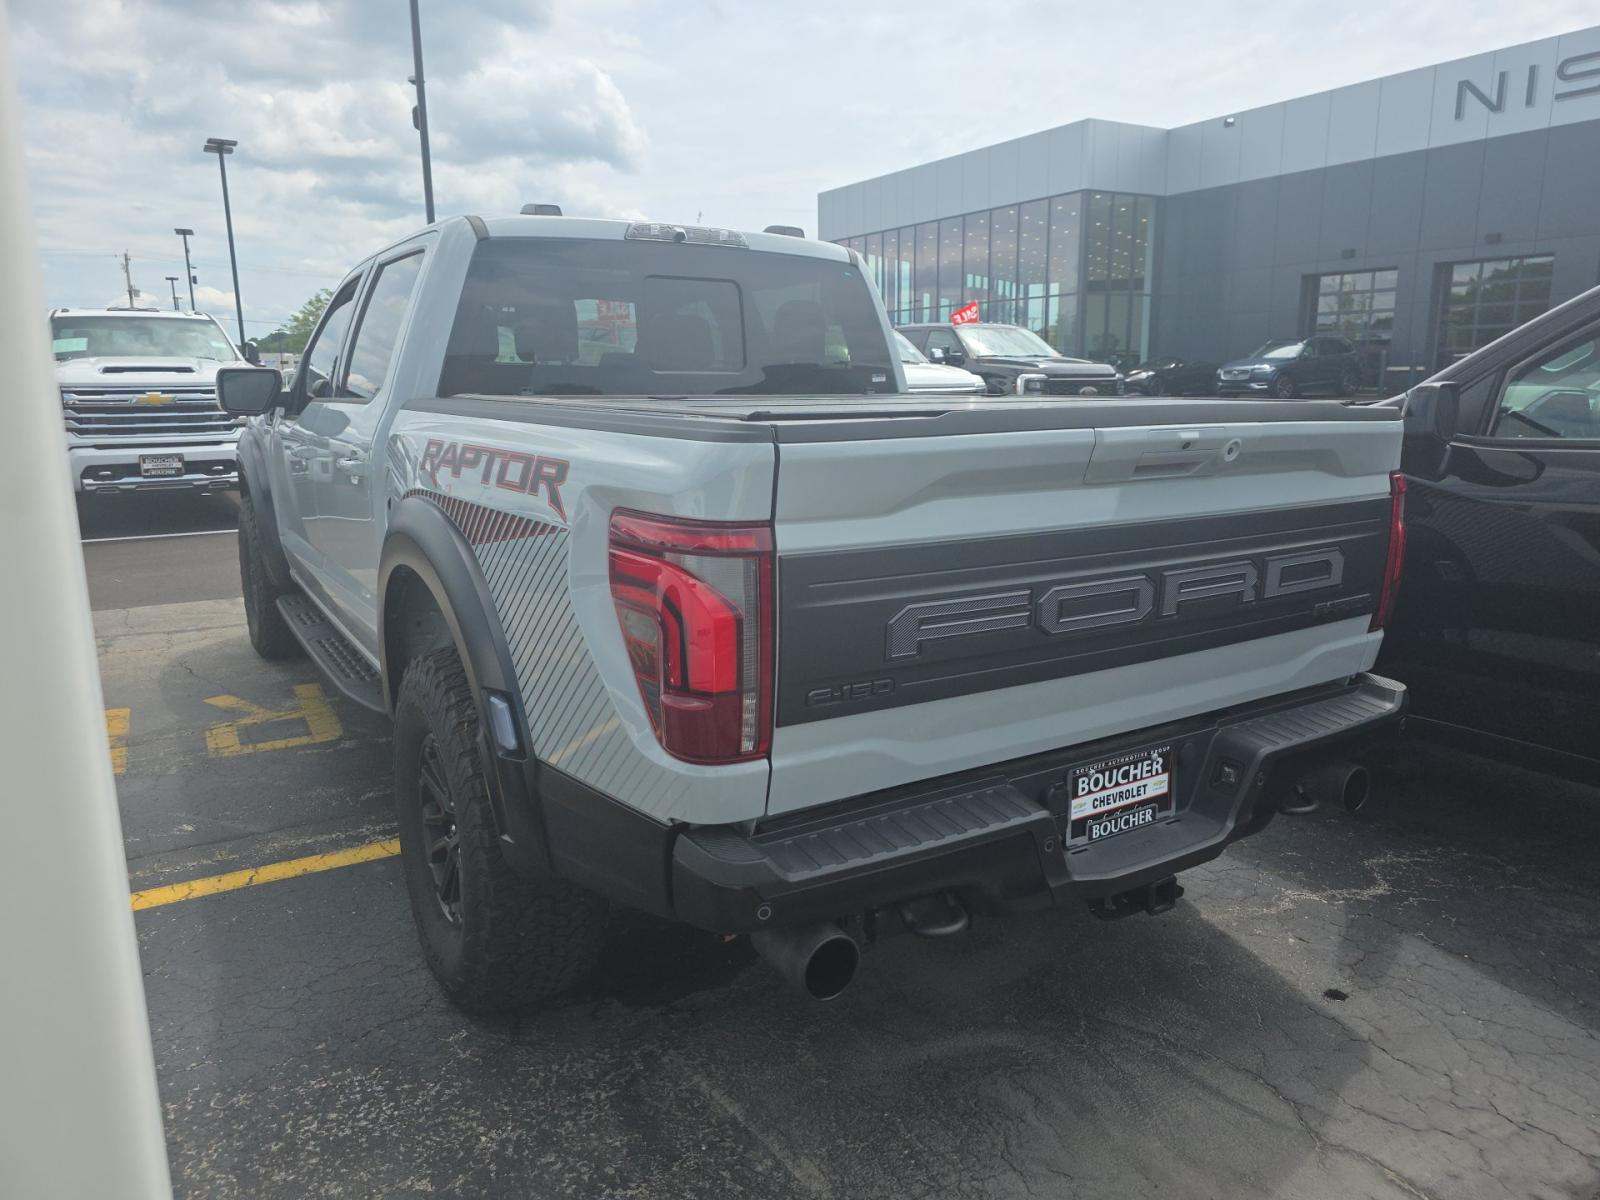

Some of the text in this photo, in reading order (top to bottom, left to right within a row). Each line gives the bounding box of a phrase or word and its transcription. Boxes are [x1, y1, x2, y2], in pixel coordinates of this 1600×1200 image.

[421, 439, 569, 523] RAPTOR
[886, 547, 1346, 661] FORD
[805, 677, 896, 706] F-150
[1077, 756, 1164, 796] BOUCHER
[1092, 784, 1149, 809] CHEVROLET
[1091, 808, 1154, 839] BOUCHER
